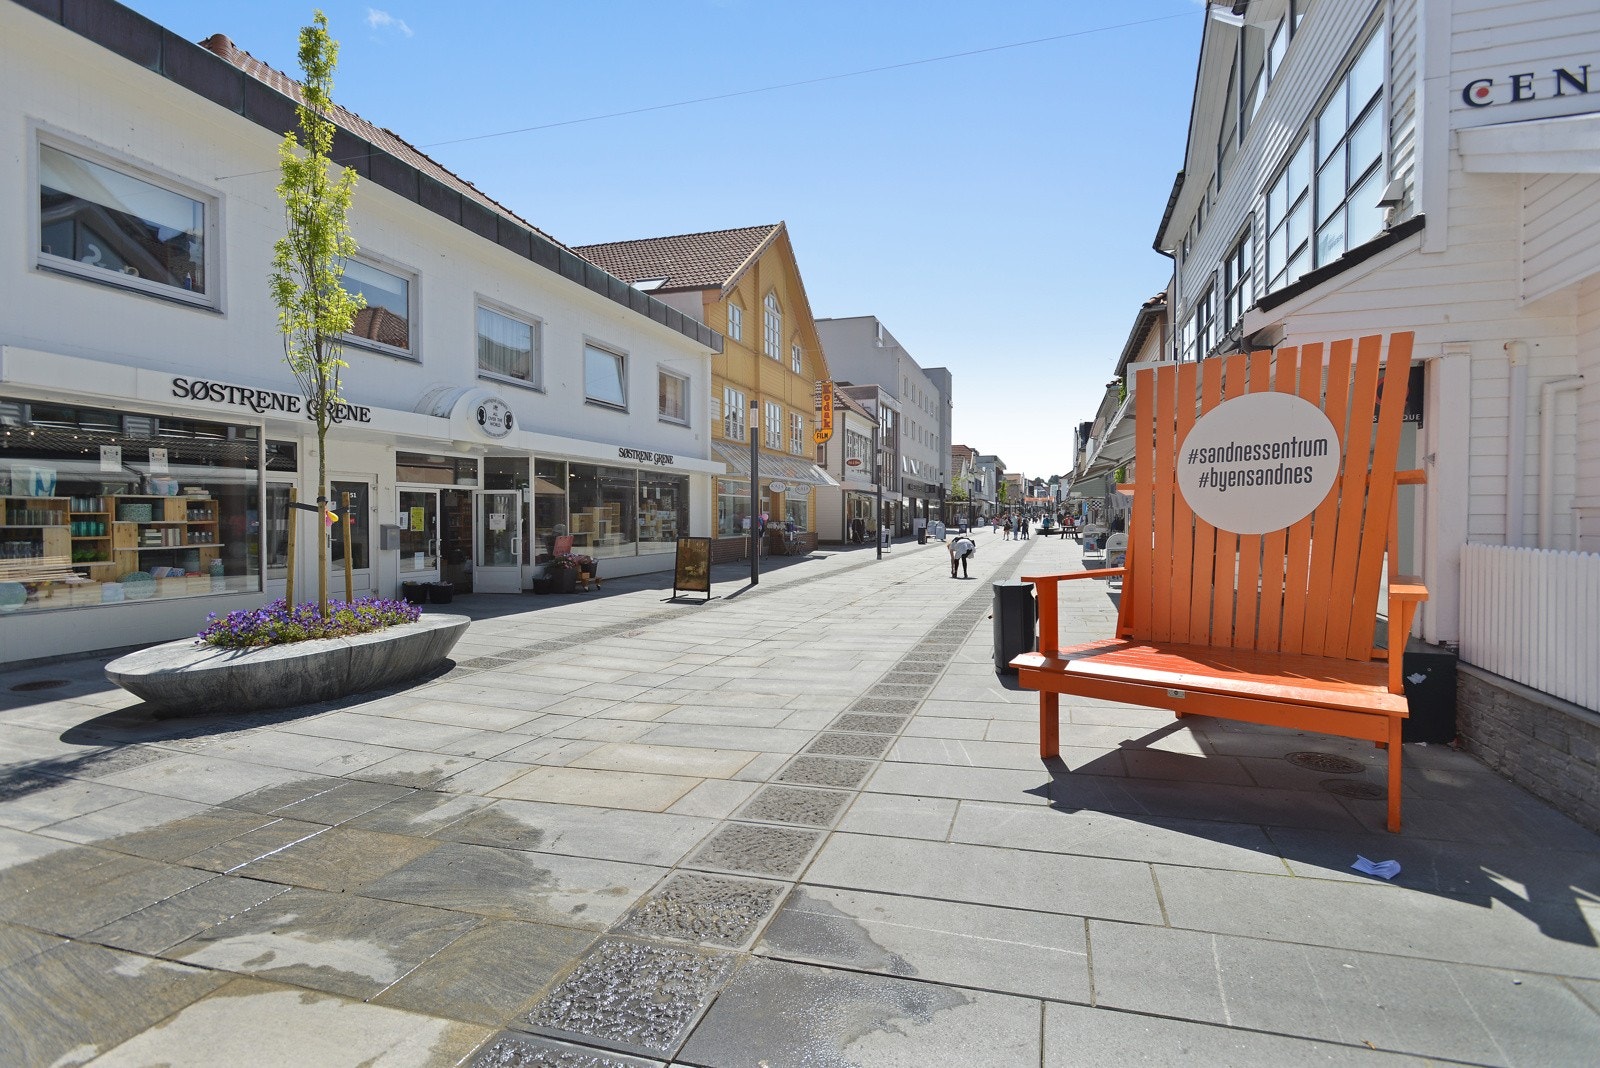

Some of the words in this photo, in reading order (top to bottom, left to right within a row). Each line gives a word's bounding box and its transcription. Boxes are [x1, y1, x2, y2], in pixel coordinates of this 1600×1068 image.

[1462, 64, 1591, 108] CEN
[172, 377, 300, 413] SØSTRENE
[822, 384, 831, 428] Kodak
[618, 447, 653, 463] SØSTRENE
[653, 452, 674, 465] GRENE
[1188, 436, 1327, 465] #sandnessentrum
[1198, 463, 1313, 492] #byensandnes
